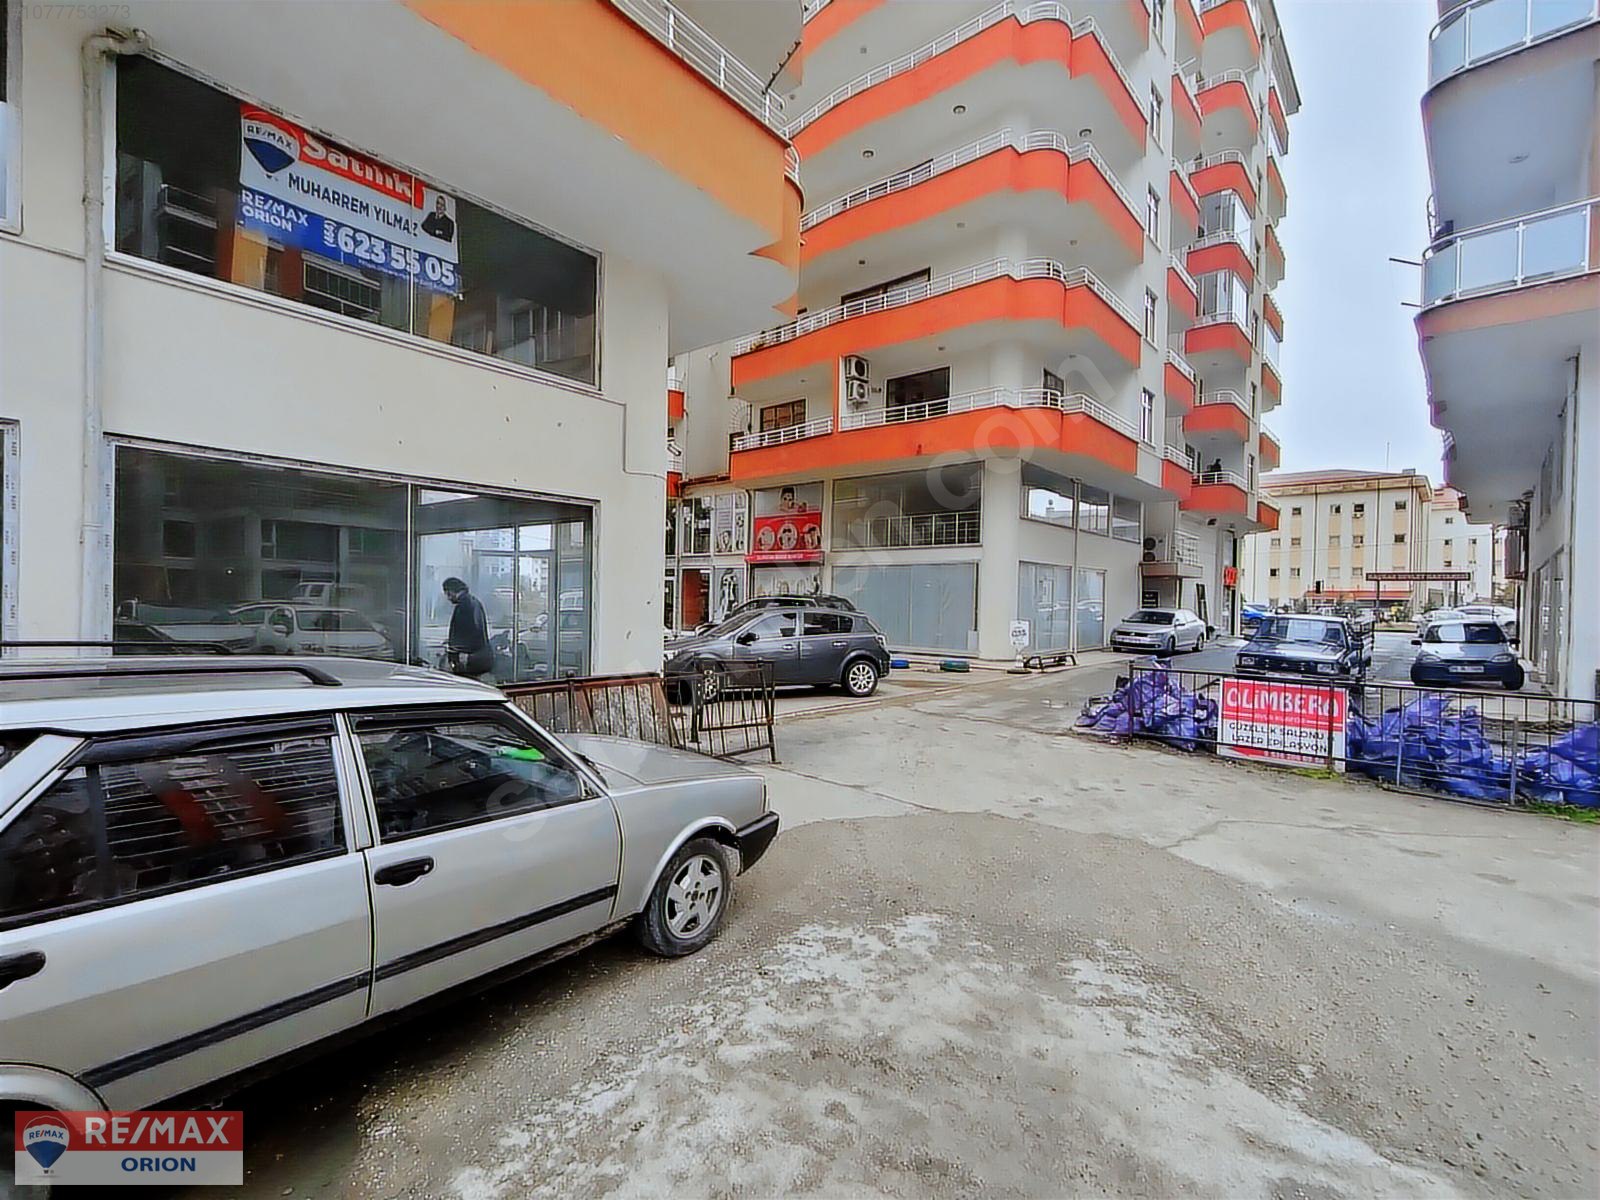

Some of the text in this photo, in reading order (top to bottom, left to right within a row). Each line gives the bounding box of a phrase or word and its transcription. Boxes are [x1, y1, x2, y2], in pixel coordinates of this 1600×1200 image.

[246, 124, 293, 150] RE/MAX
[241, 189, 309, 227] RE/MAX
[287, 172, 370, 218] MUHARREM
[241, 204, 293, 233] ORION
[337, 225, 387, 265] 623
[390, 244, 421, 274] 55
[425, 256, 455, 287] 05
